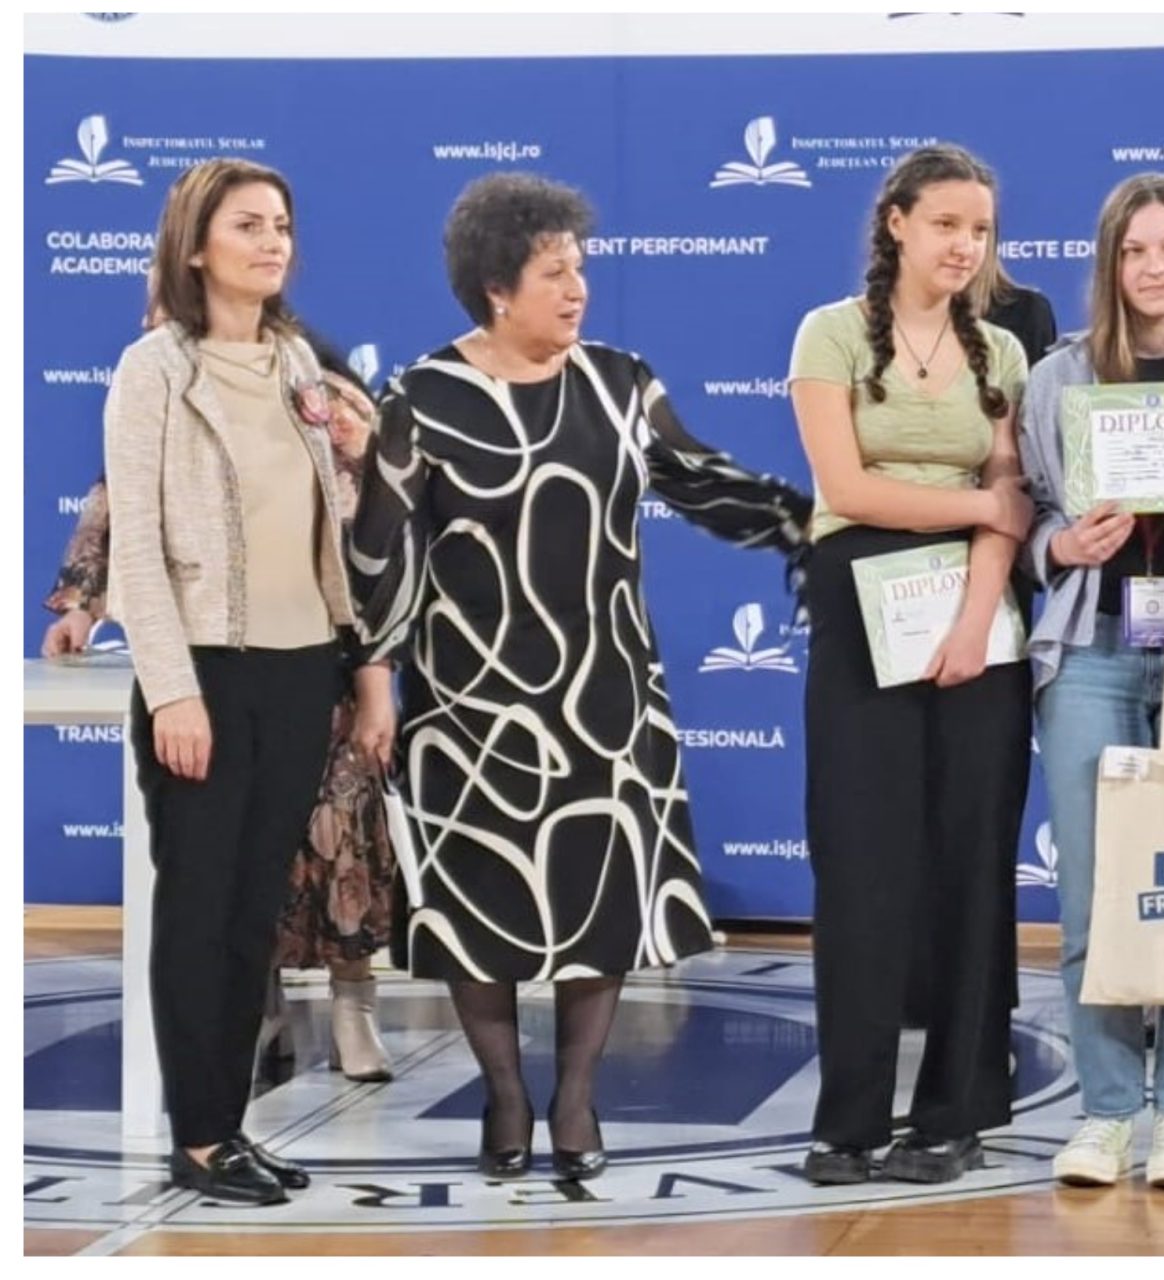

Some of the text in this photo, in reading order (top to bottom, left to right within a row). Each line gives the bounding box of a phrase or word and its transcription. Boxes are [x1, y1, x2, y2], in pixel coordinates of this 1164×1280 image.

[433, 142, 541, 162] www.isjcj.ro
[46, 231, 158, 250] COLABORA
[631, 236, 769, 256] PERFORMANT
[997, 240, 1059, 258] IECTE
[43, 366, 113, 388] www.isj
[704, 377, 788, 399] www.isjcj
[55, 724, 123, 743] TRANS
[723, 839, 811, 858] www.isjcj.
